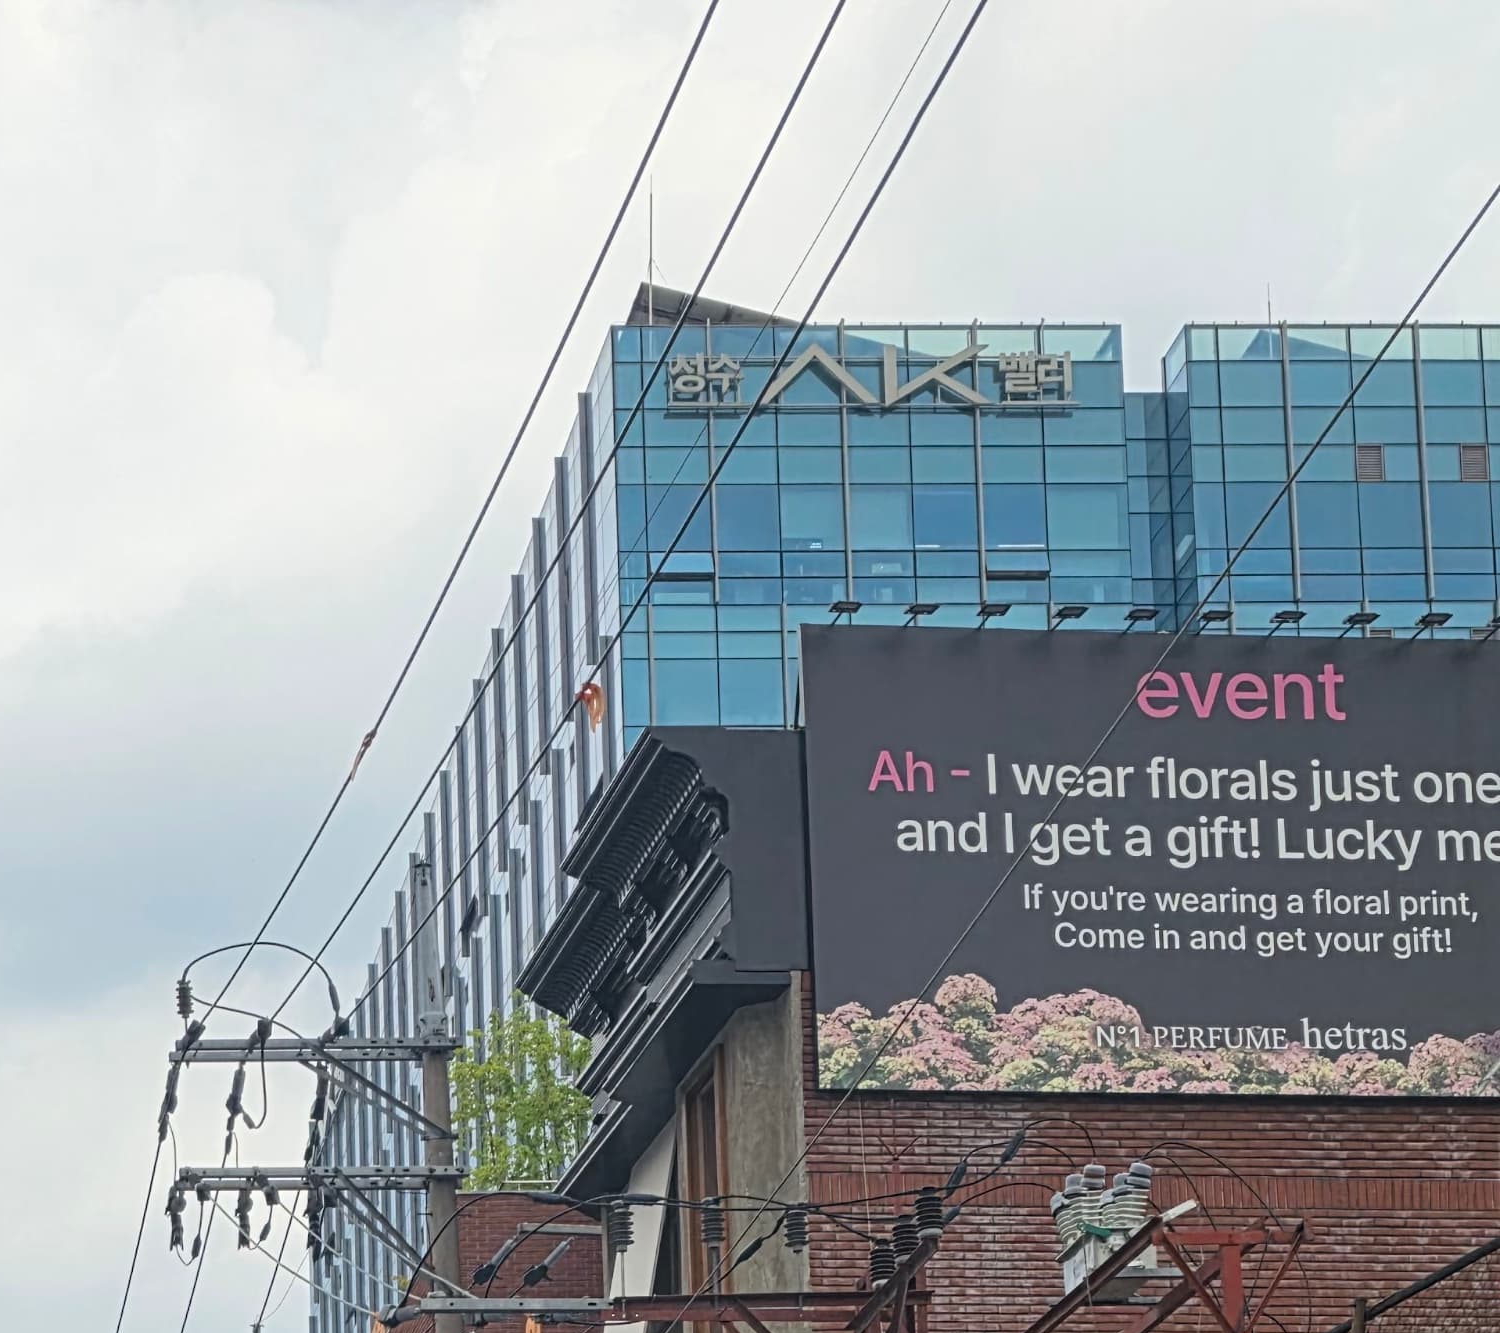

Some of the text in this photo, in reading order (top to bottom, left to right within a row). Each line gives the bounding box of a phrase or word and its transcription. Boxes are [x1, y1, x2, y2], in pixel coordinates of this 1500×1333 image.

[669, 353, 741, 394] 성수
[1136, 663, 1346, 721] event
[868, 751, 934, 792] Ah
[987, 754, 996, 795] I
[1012, 764, 1134, 797] wear
[1147, 756, 1297, 801] florals
[1310, 759, 1400, 811] just
[1414, 771, 1500, 804] one
[897, 812, 987, 853] and
[1005, 813, 1014, 853] I
[1030, 817, 1111, 865] get
[1124, 825, 1151, 857] a
[1167, 816, 1260, 869] gift!
[1277, 818, 1422, 871] Lucky
[1023, 884, 1479, 922] If you're wearing a floral print,
[1054, 922, 1453, 959] Come in and get your gift!
[1153, 1026, 1287, 1050] PERFUME
